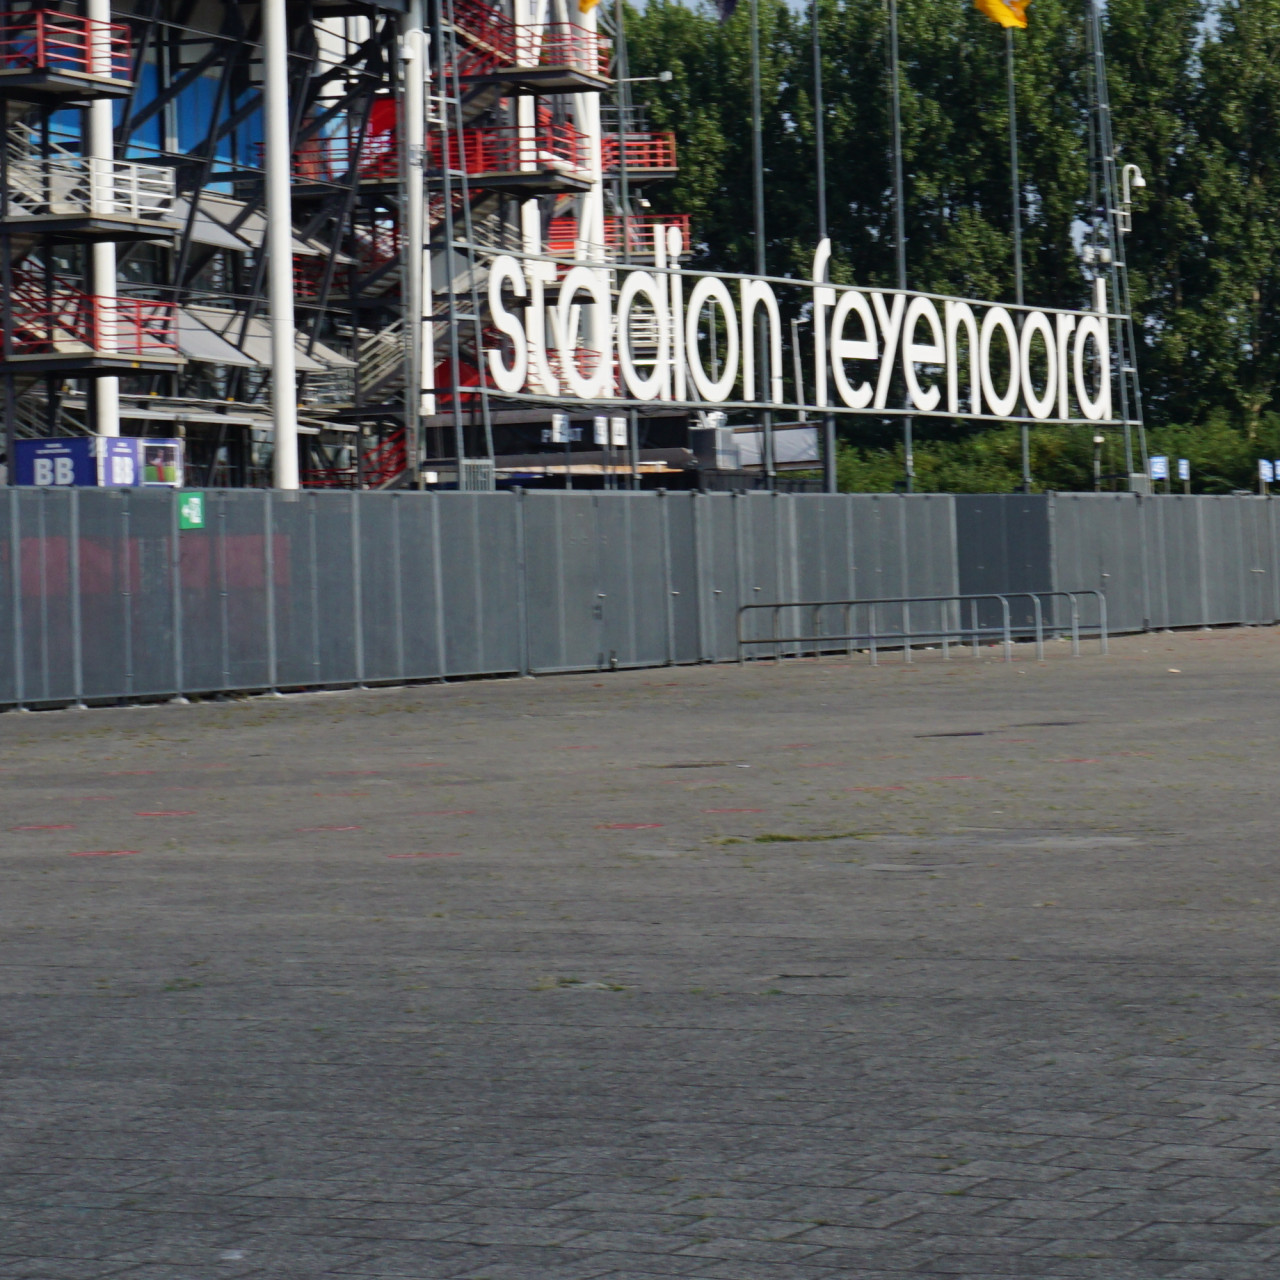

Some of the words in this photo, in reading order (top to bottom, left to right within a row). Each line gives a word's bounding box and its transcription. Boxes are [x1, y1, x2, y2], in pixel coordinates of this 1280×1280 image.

[488, 224, 783, 403] stadion
[813, 238, 1111, 420] feyenoord
[33, 457, 75, 486] BB
[111, 456, 135, 485] BB
